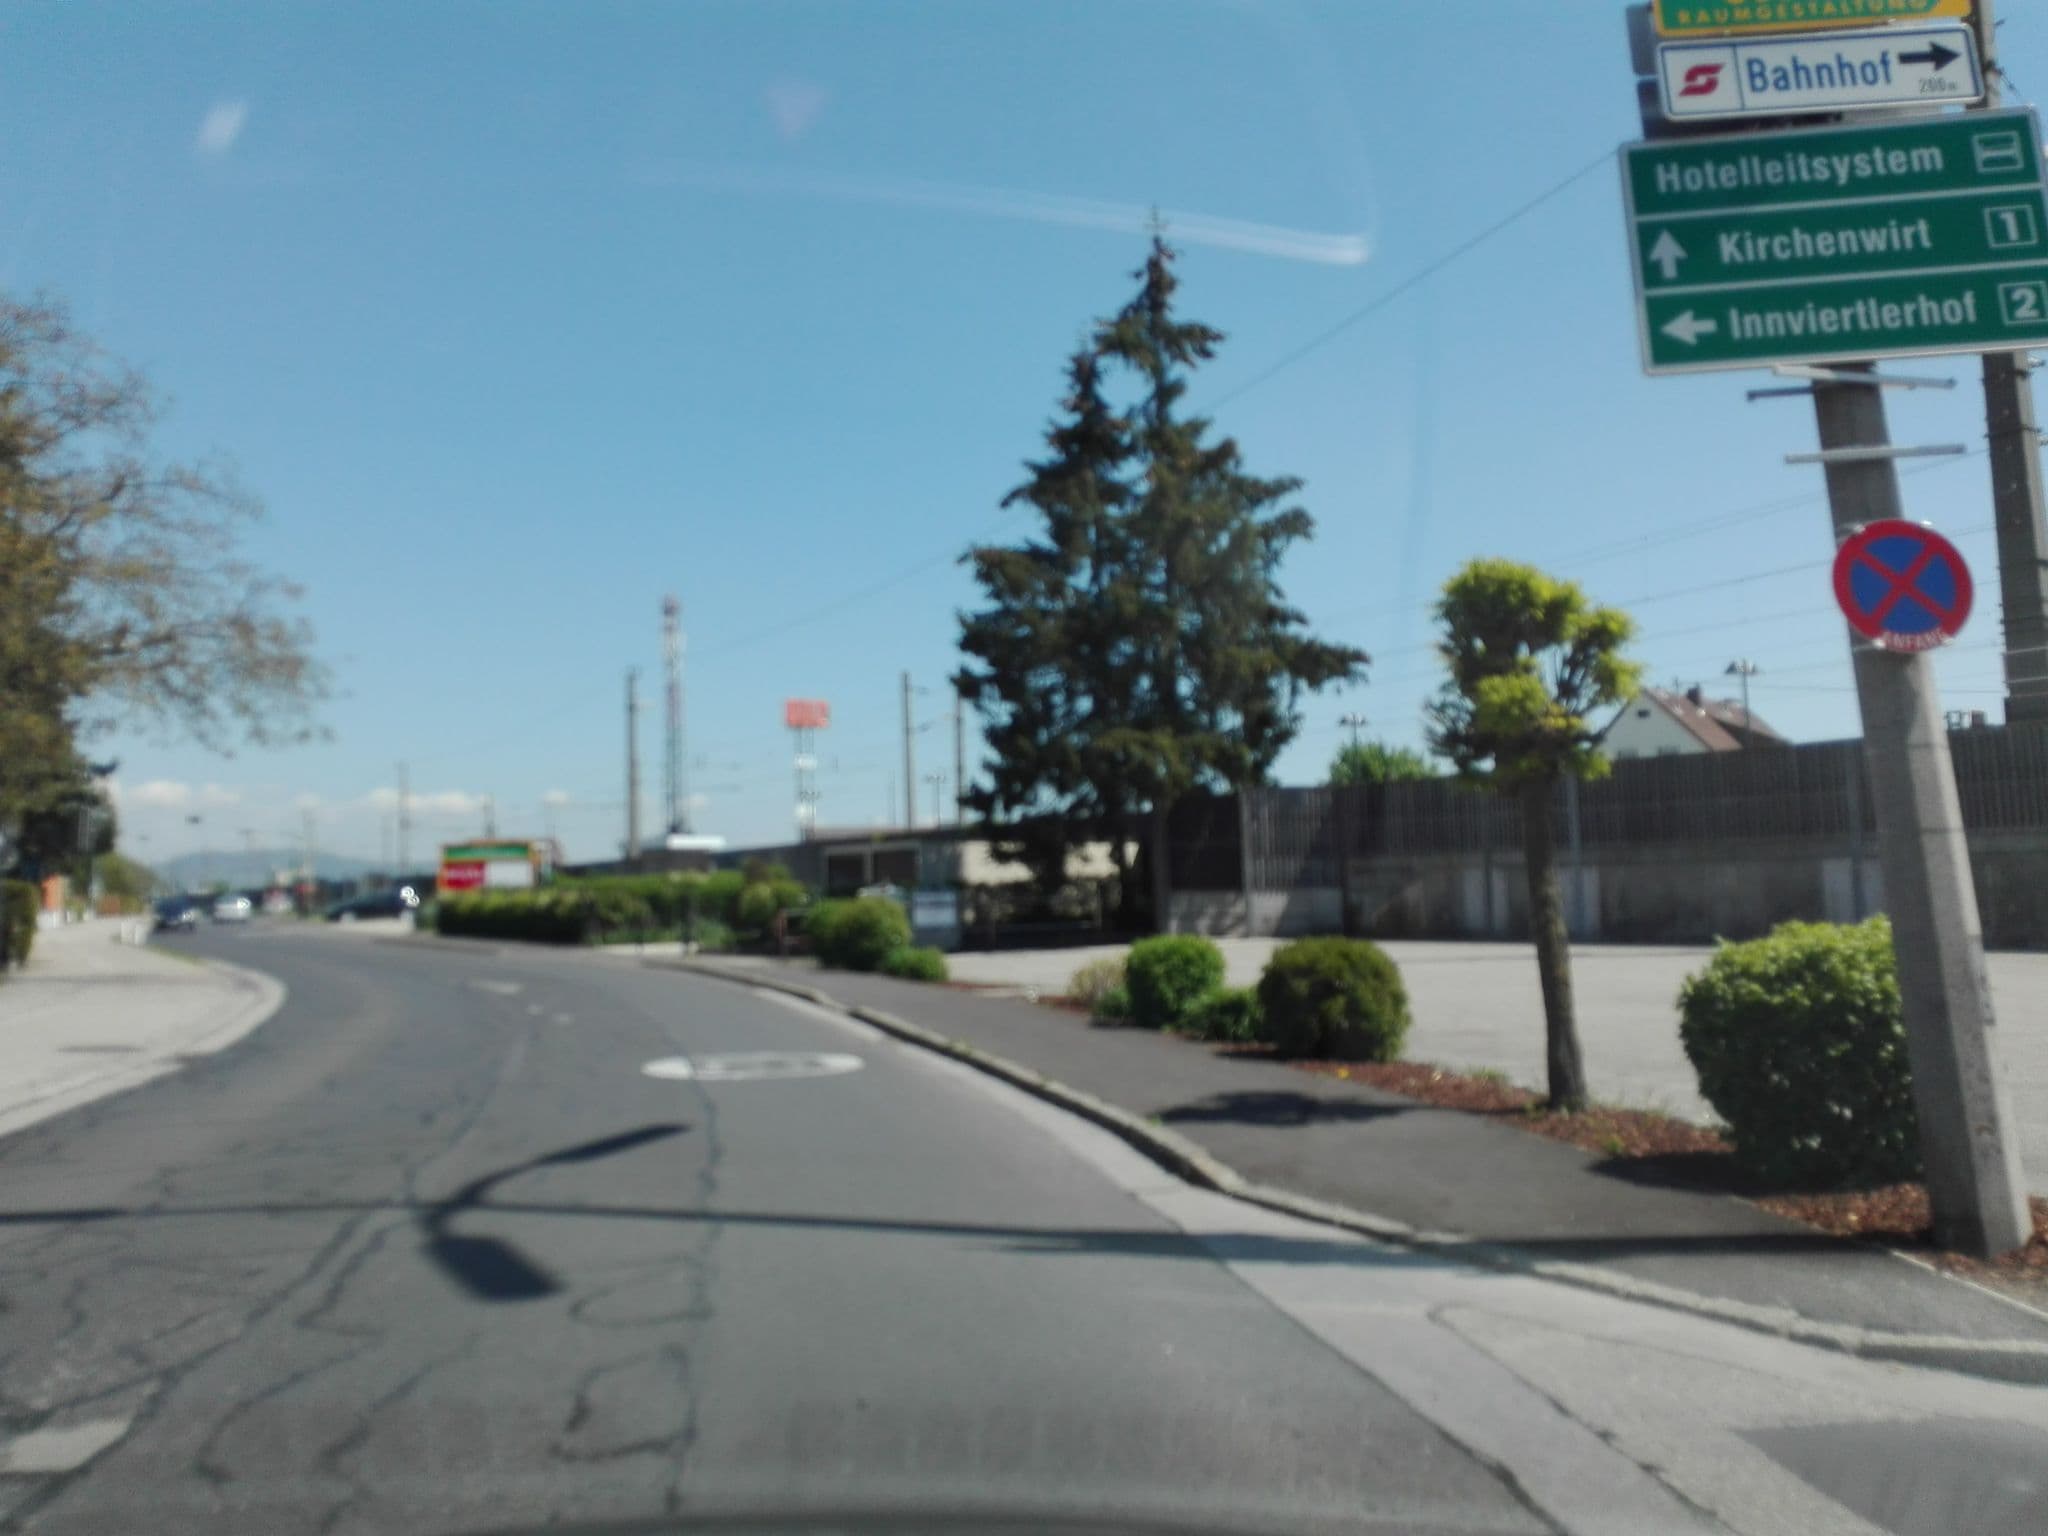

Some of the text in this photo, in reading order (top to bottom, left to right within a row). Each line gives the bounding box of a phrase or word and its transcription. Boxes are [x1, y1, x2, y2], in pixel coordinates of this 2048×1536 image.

[1747, 51, 1892, 94] Bahnhof
[1657, 146, 1944, 194] Hotelleitsystem
[1719, 213, 2020, 264] Kirchenwirt 1
[1729, 287, 2039, 340] Innviertlerhof 2
